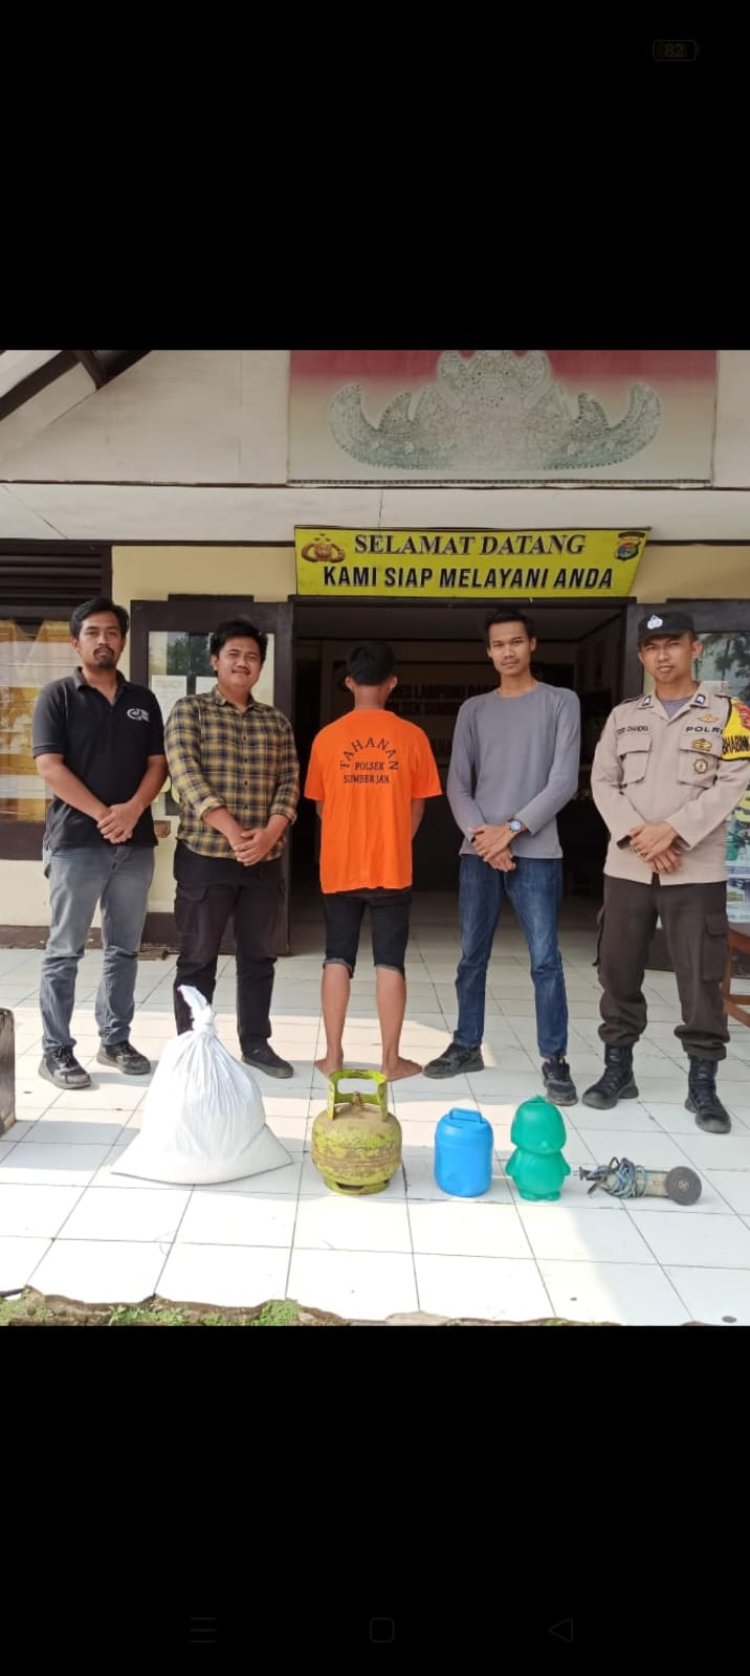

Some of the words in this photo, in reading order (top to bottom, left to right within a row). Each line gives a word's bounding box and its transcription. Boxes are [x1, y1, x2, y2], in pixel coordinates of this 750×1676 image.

[354, 534, 475, 555] SELAMAT
[479, 534, 586, 555] DATANG
[323, 566, 377, 587] KAMI
[384, 567, 433, 588] SIAP
[439, 568, 549, 588] MELAYANI
[553, 568, 612, 588] ANDA
[339, 737, 399, 771] TAHANAN
[355, 761, 385, 771] POLSEK
